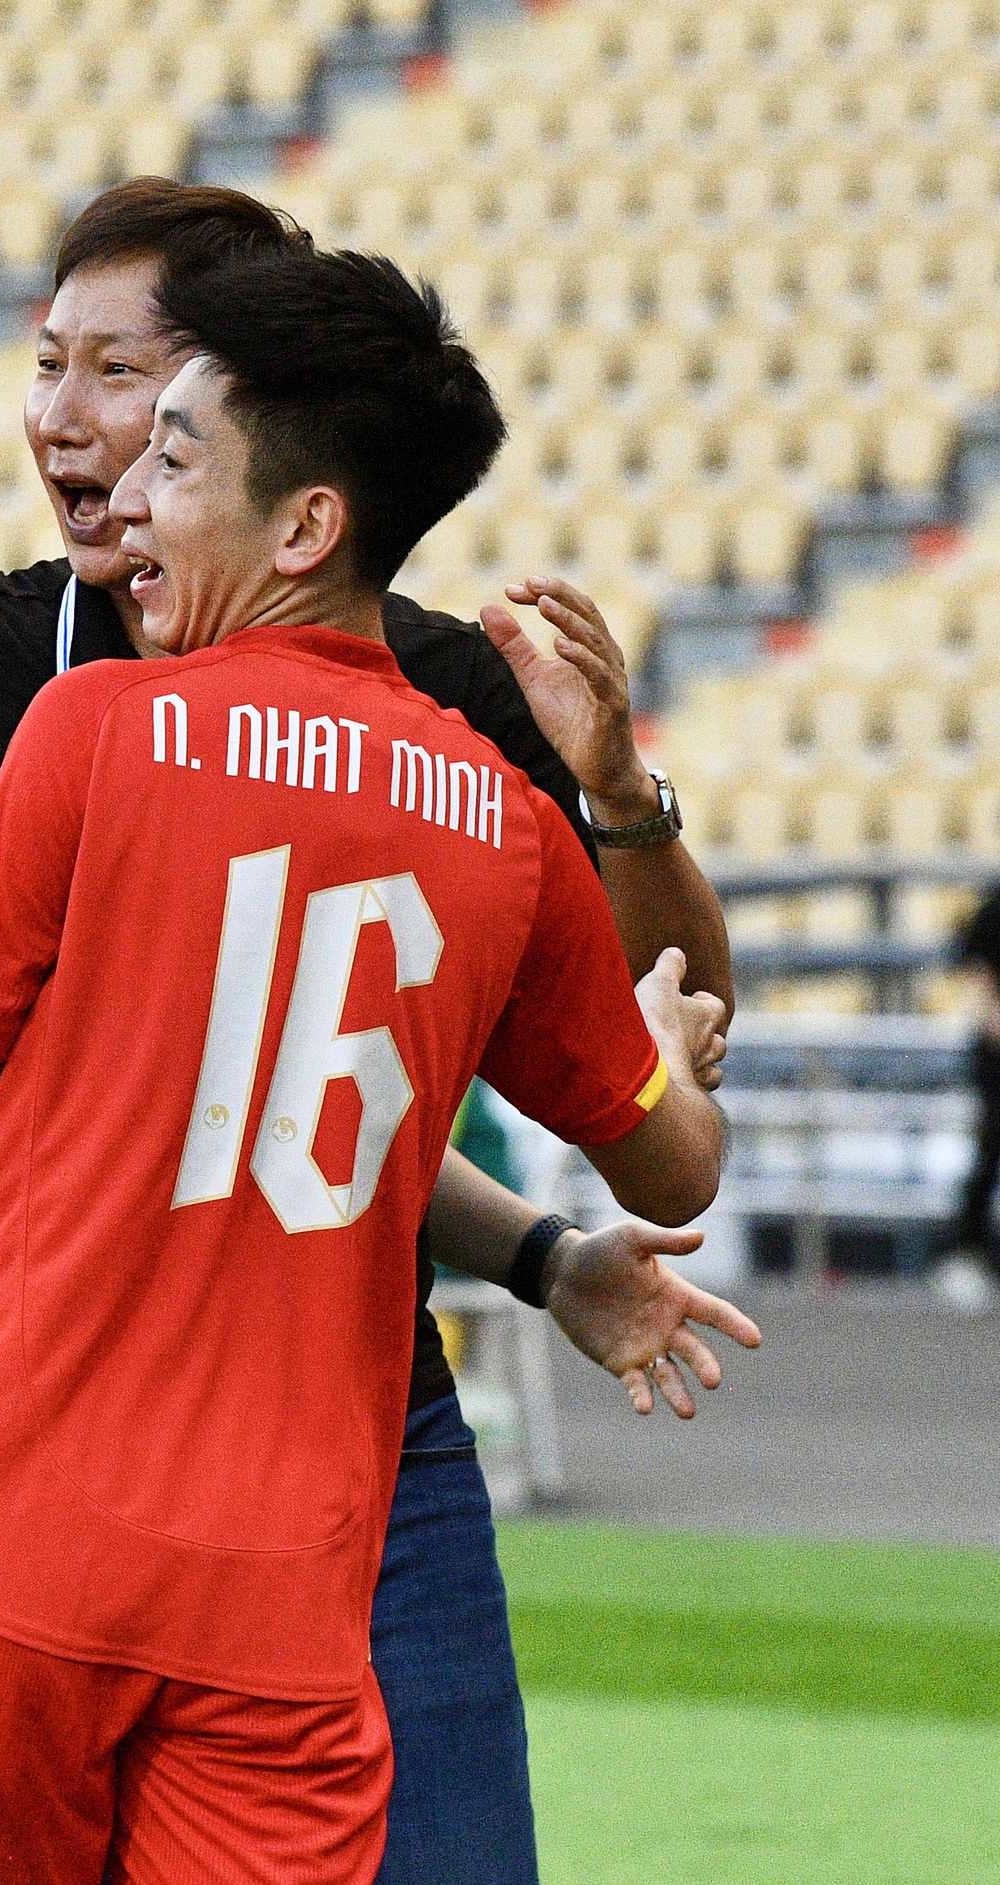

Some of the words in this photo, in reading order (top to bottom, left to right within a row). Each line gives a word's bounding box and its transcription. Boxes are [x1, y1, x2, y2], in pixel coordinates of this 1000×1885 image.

[152, 692, 201, 770] N.
[225, 702, 369, 794] NHAT
[389, 739, 503, 850] MINH
[169, 843, 445, 1235] 16
